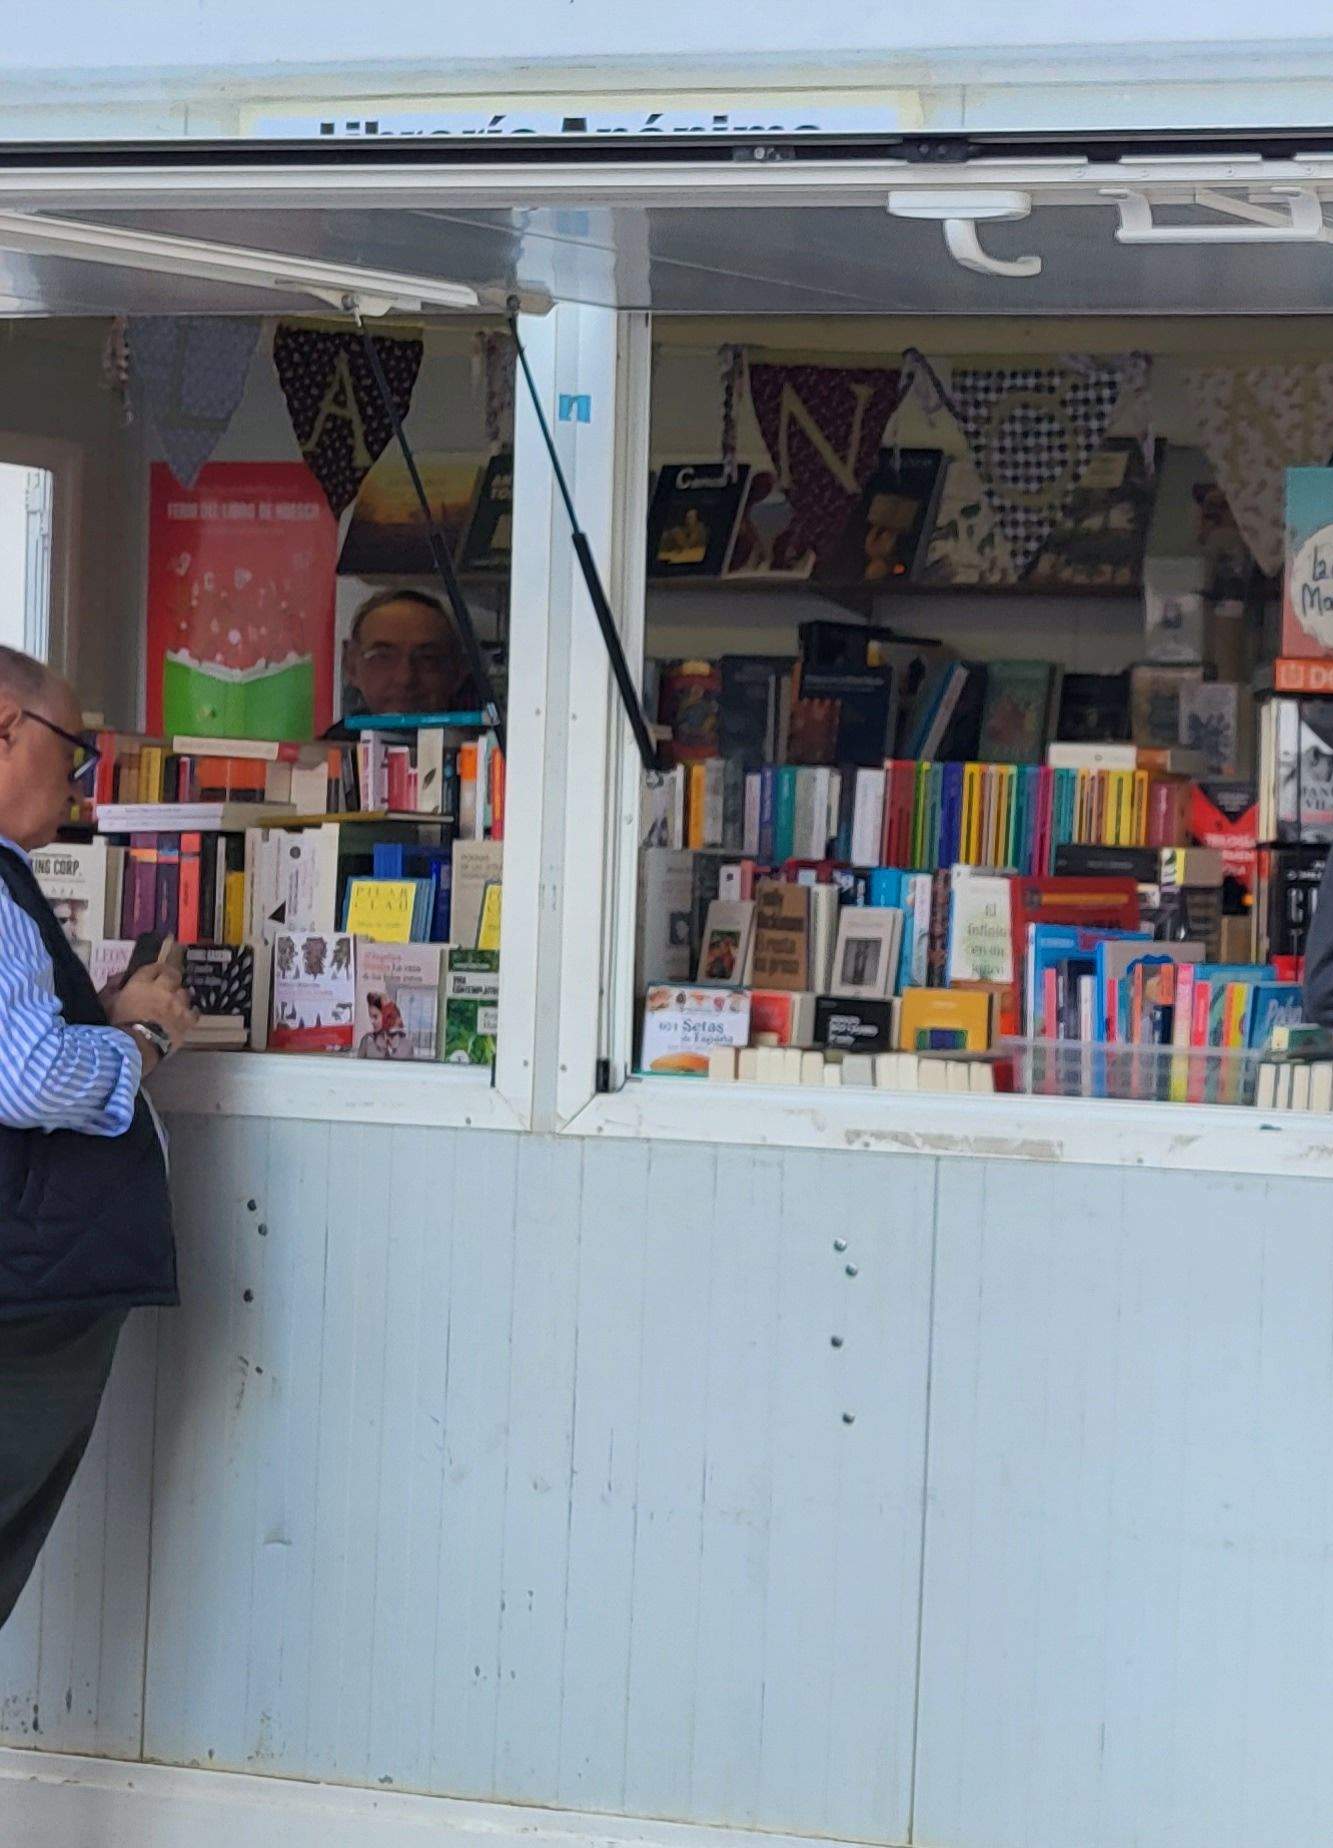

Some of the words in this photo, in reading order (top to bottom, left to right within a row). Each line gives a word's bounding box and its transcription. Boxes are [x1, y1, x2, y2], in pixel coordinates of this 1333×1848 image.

[300, 349, 374, 469] A
[779, 383, 876, 494] N
[682, 1019, 724, 1034] Setas
